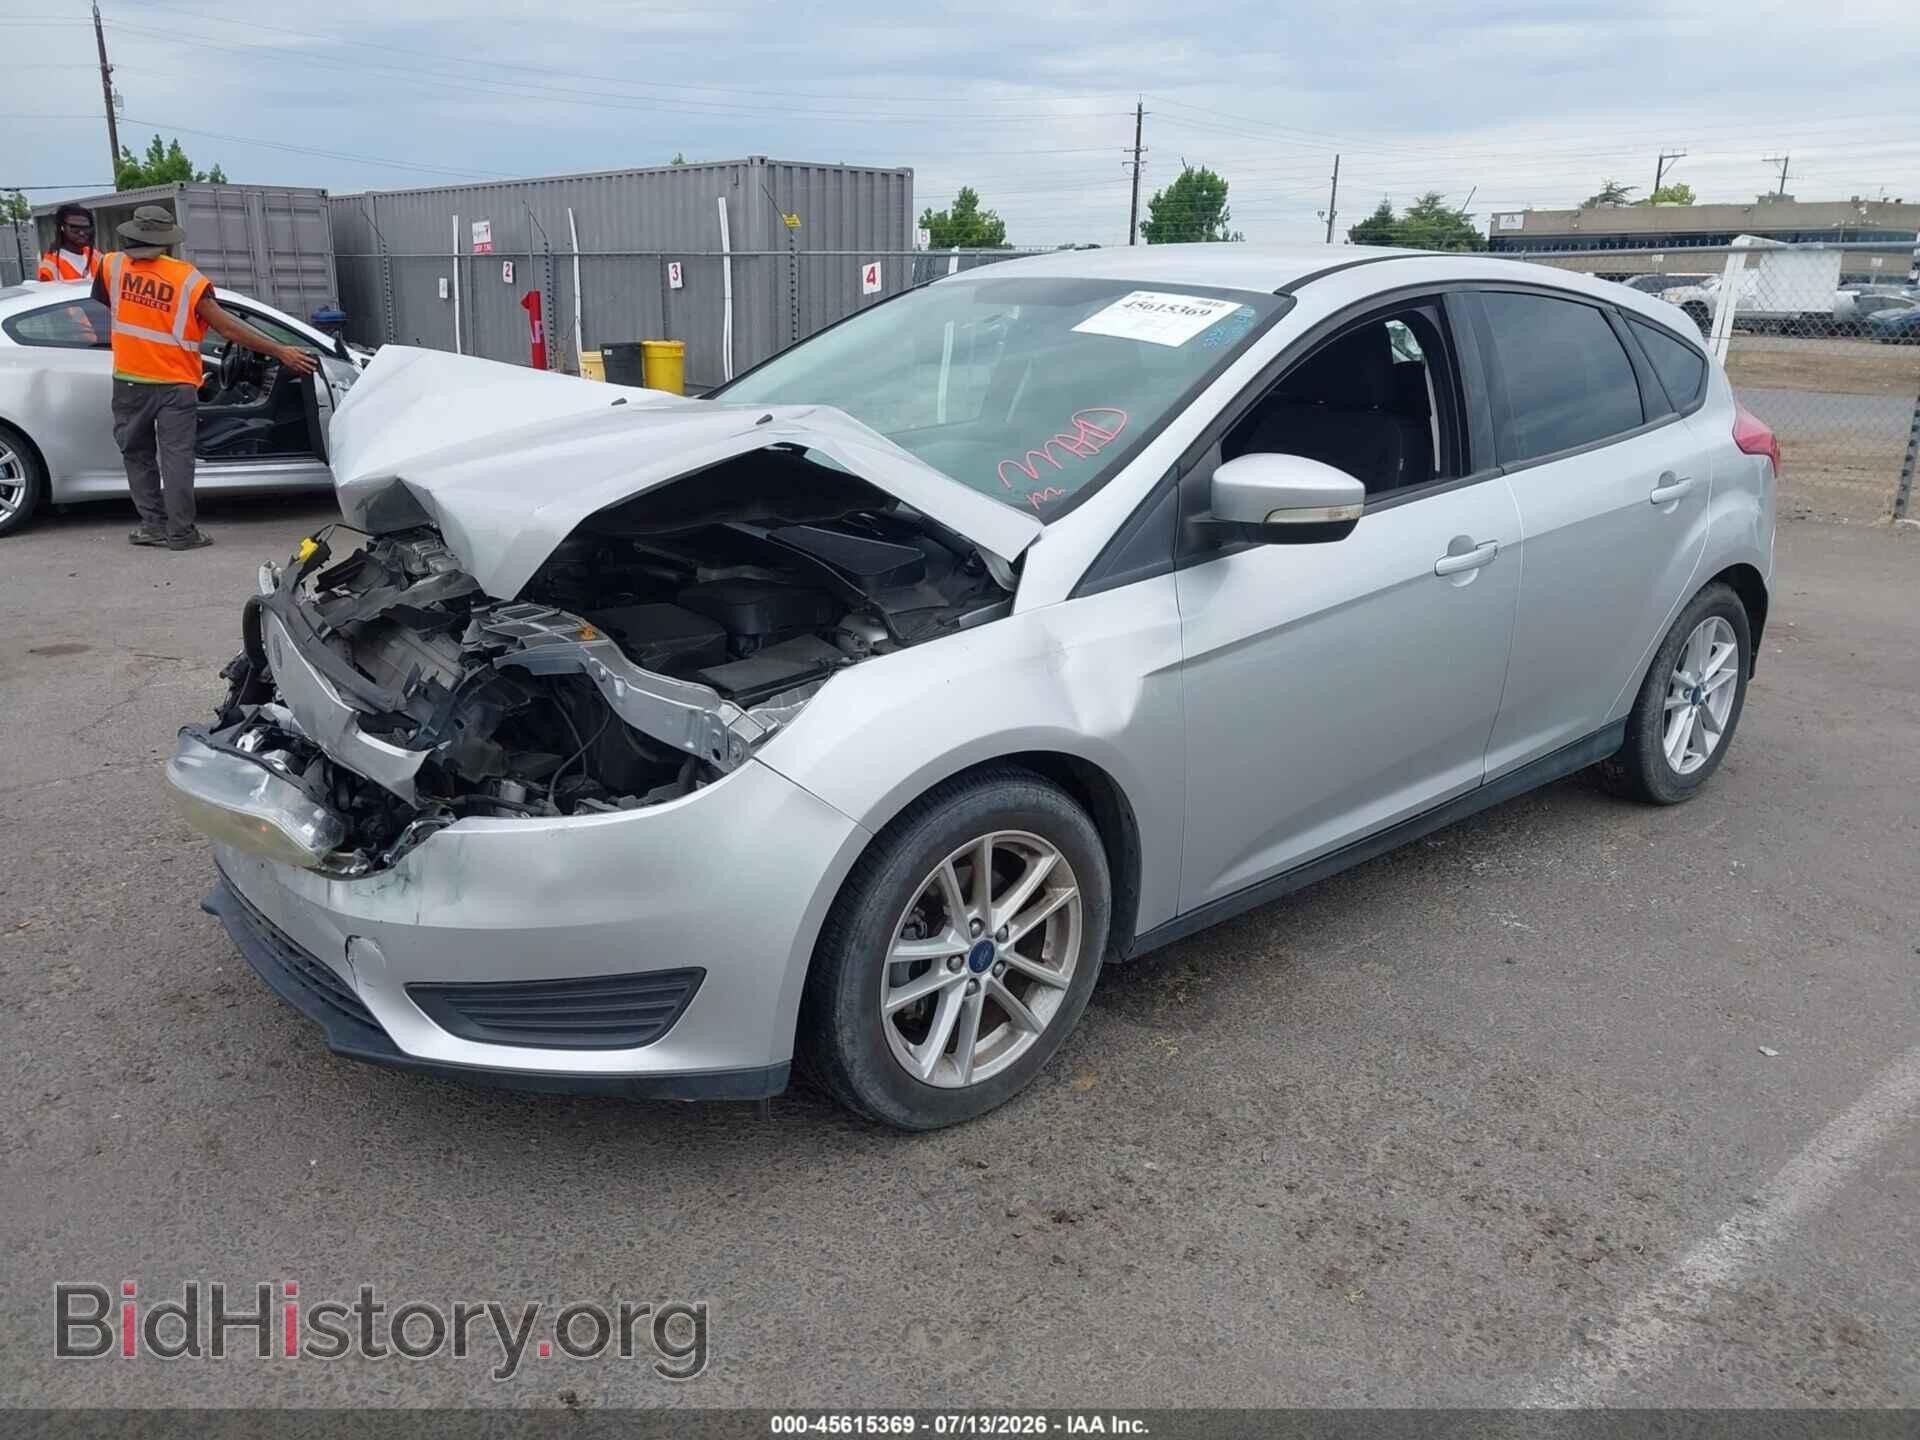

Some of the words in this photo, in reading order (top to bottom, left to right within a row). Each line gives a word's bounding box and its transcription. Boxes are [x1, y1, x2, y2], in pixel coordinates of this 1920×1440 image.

[504, 263, 511, 278] 2
[671, 264, 679, 281] 3
[865, 266, 876, 285] 4
[122, 272, 175, 304] MAD
